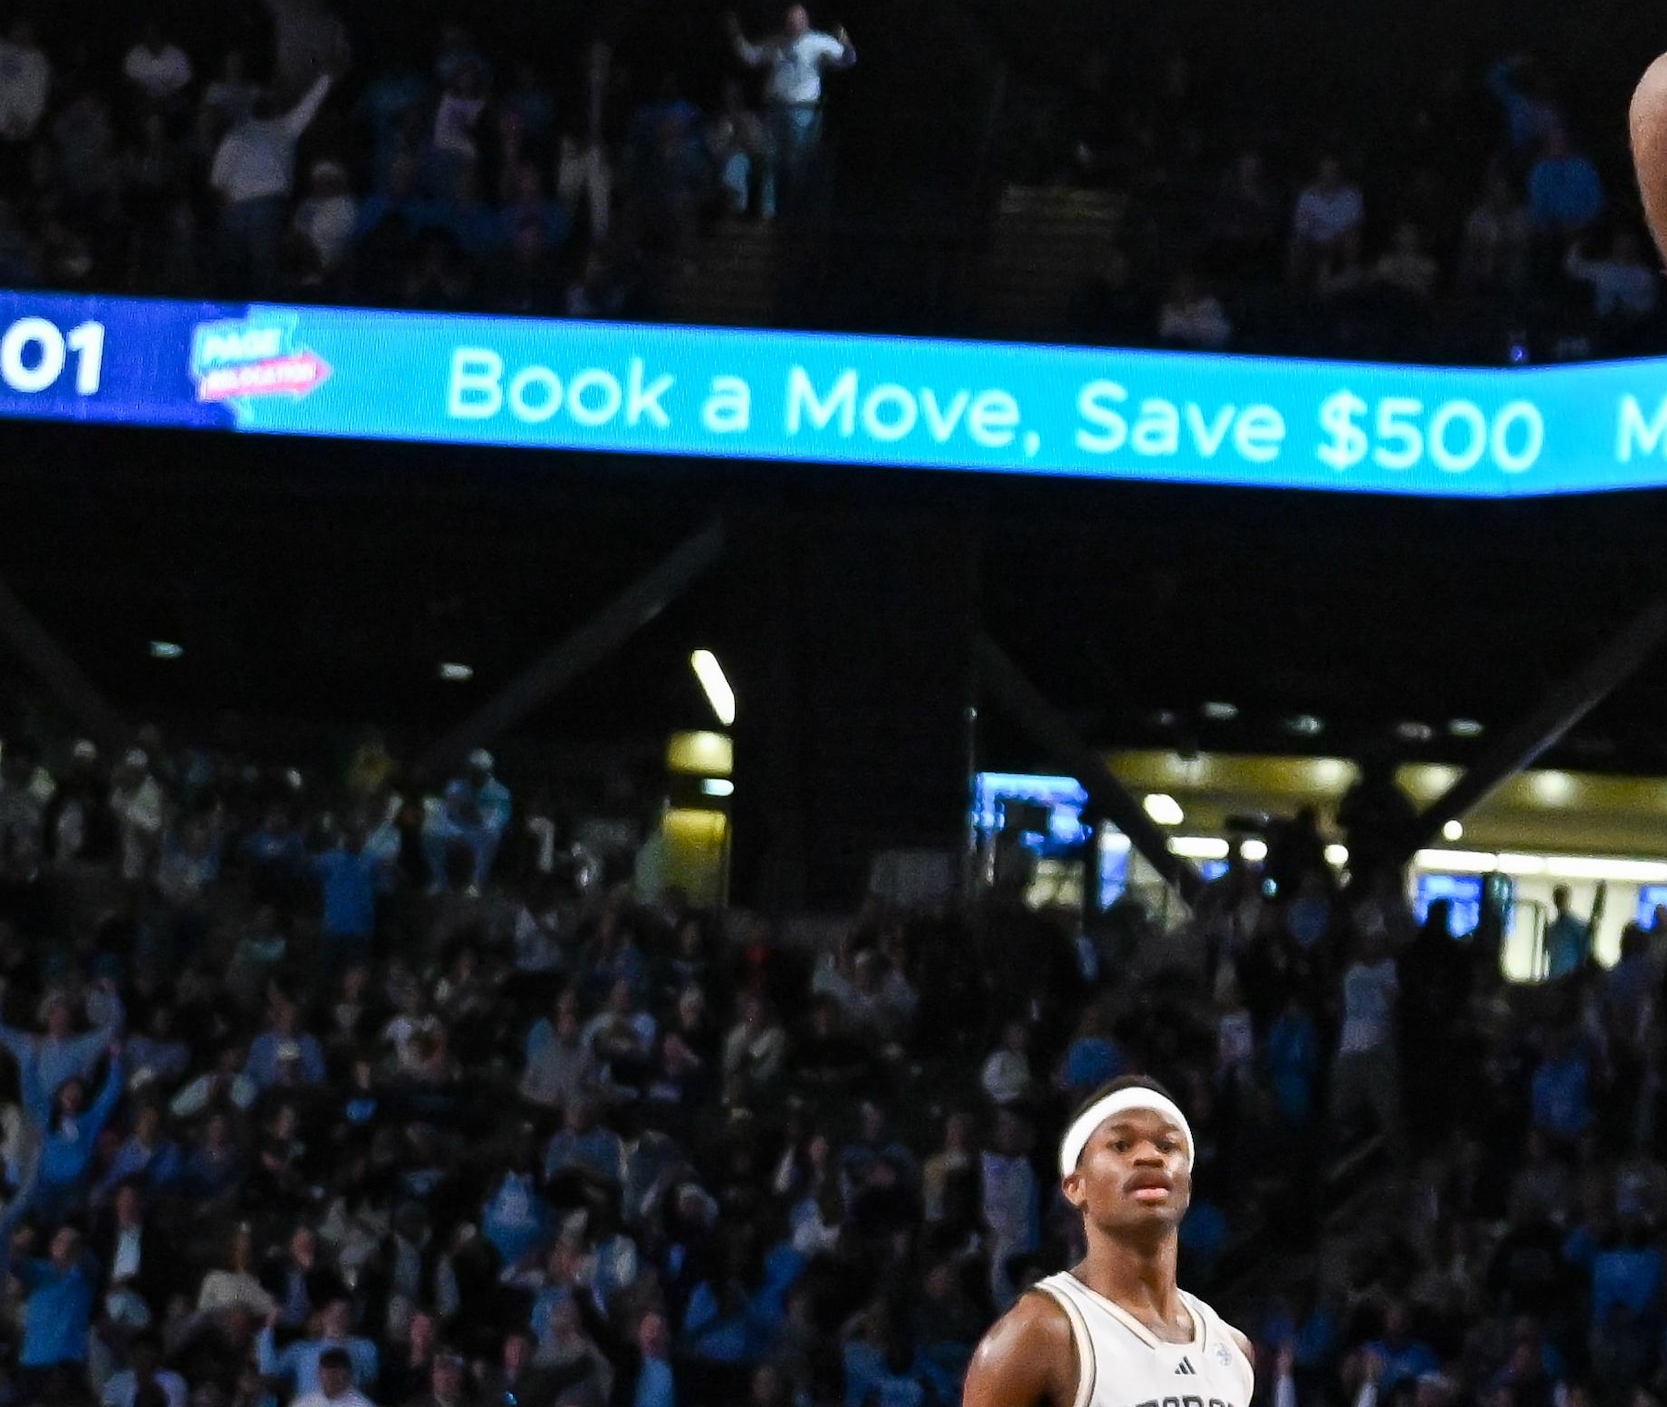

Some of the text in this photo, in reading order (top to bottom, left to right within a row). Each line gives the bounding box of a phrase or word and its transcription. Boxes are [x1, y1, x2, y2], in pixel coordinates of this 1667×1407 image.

[0, 315, 106, 396] 01
[445, 345, 675, 431] Book
[700, 373, 752, 435] a
[783, 363, 1041, 459] Move,
[1074, 377, 1286, 463] Save
[1314, 386, 1546, 474] $500
